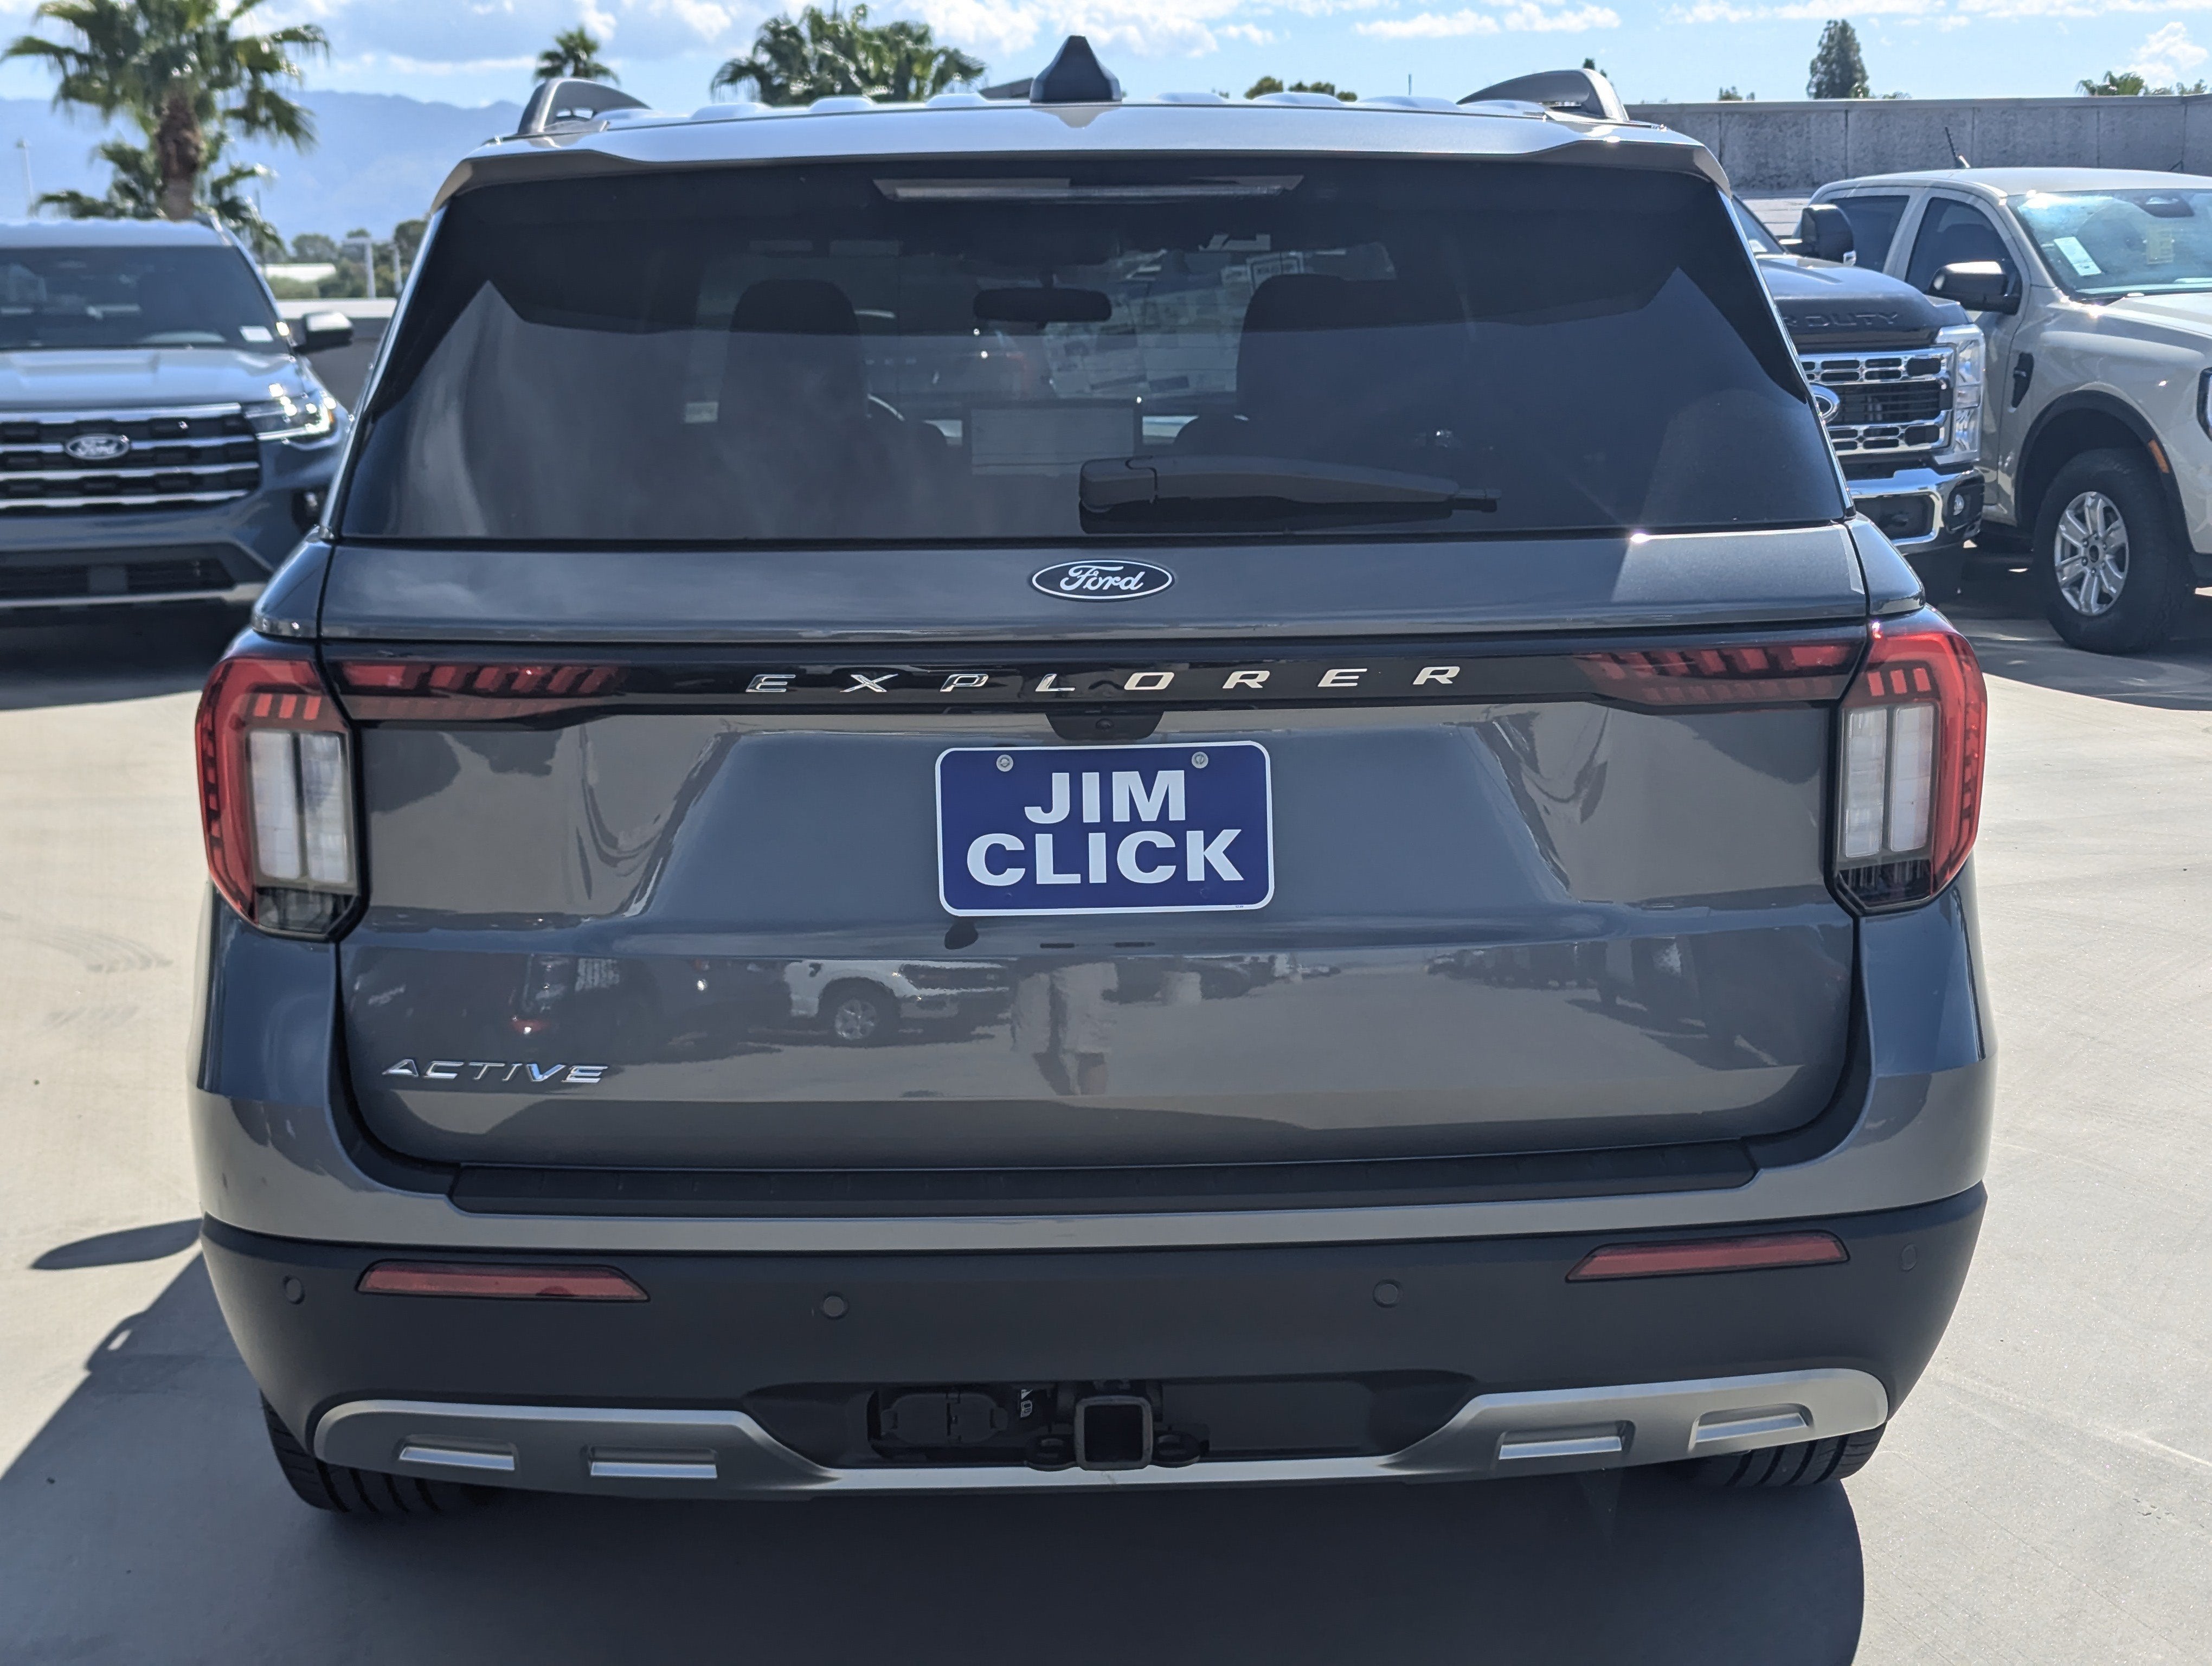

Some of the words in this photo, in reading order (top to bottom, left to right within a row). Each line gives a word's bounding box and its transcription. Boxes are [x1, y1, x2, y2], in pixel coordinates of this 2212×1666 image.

[1060, 565, 1145, 590] Ford
[746, 665, 1462, 694] EXPLORER
[1024, 771, 1186, 824] JIM
[967, 829, 1244, 887] CLICK
[382, 1059, 608, 1084] ACTIVE
